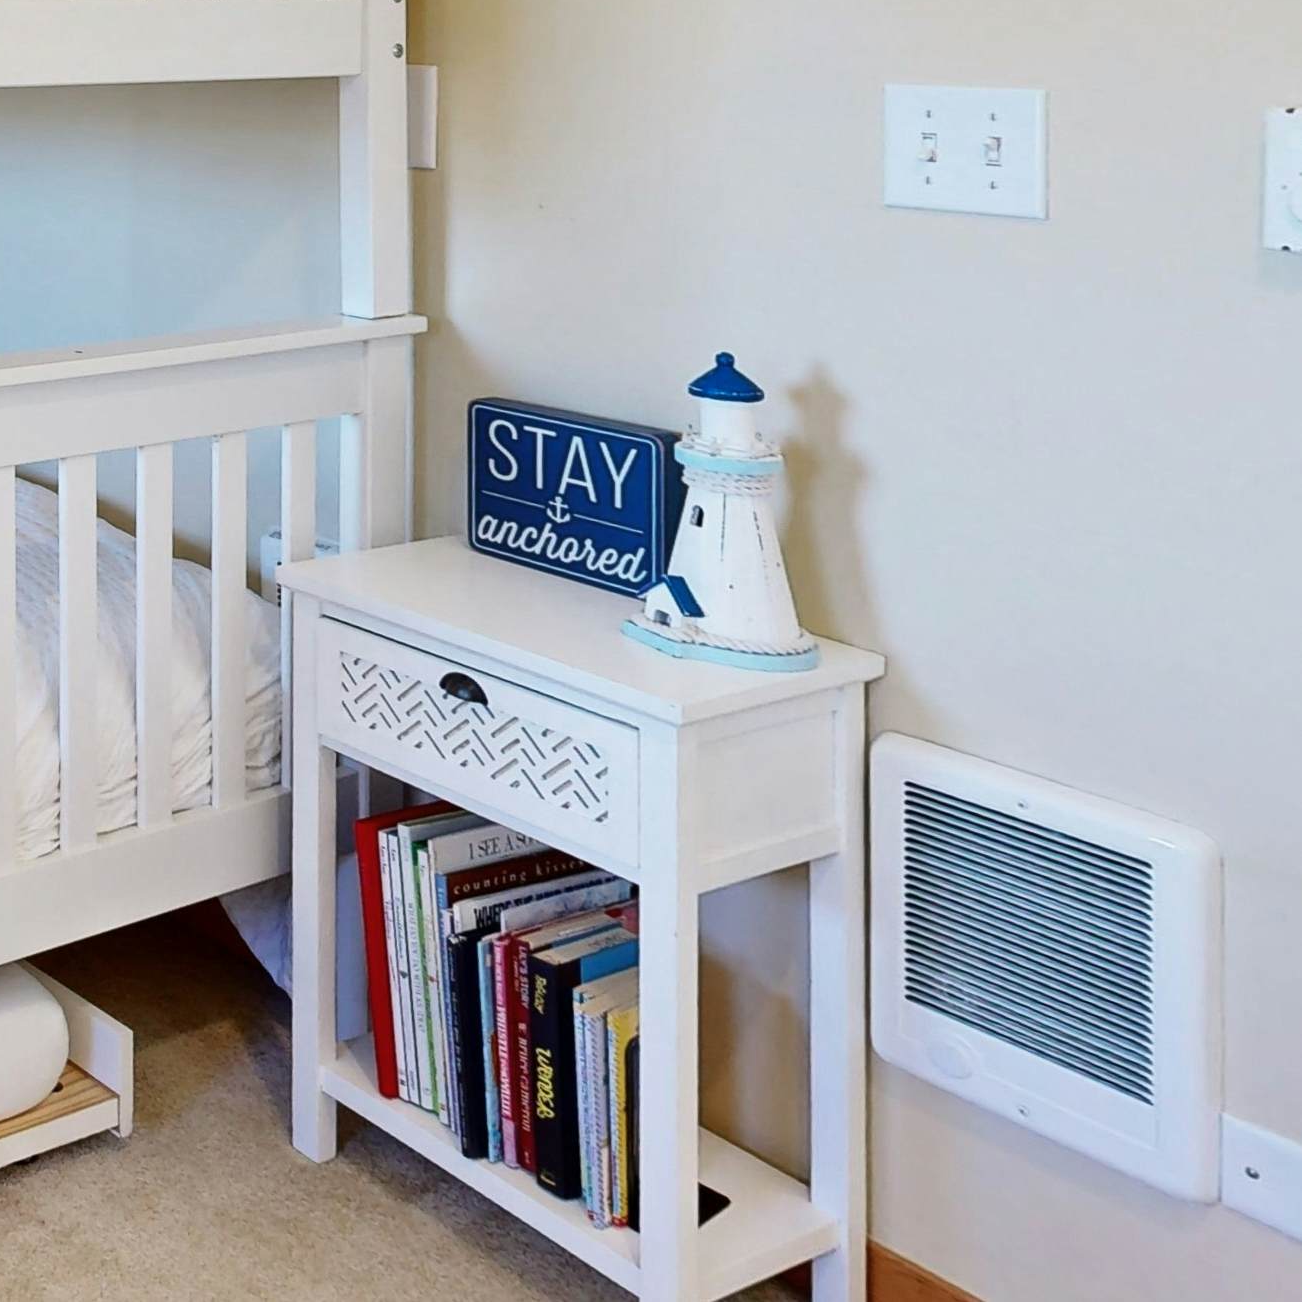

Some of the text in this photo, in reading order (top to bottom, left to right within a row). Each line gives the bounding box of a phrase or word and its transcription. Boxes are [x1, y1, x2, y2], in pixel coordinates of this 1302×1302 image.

[487, 419, 638, 509] STAY
[477, 512, 648, 583] anchored
[477, 836, 501, 858] SEE
[453, 869, 528, 896] counting
[535, 859, 585, 878] kisses
